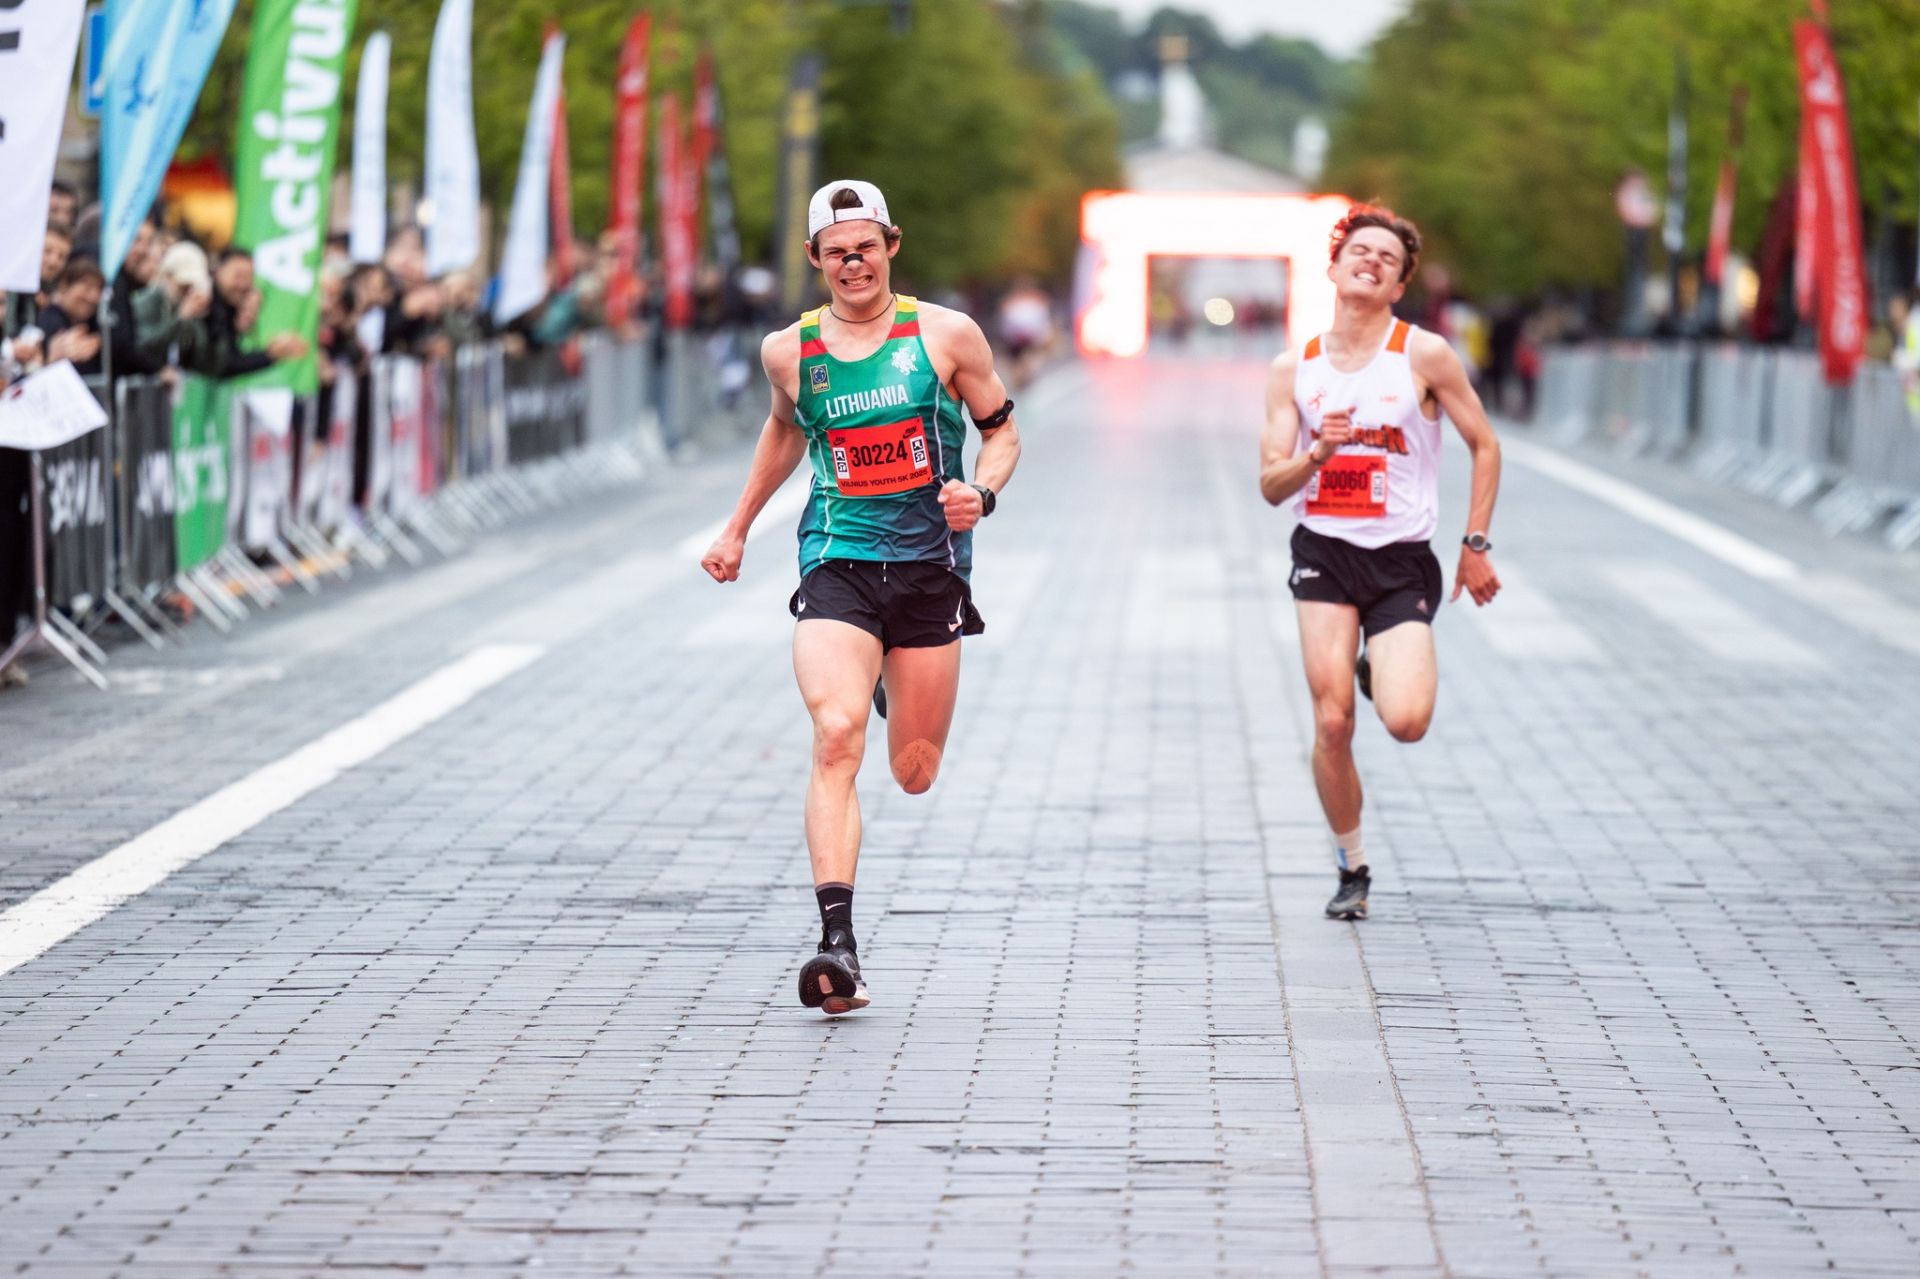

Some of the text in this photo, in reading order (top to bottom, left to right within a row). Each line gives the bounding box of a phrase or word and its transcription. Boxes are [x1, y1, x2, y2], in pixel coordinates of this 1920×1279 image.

[253, 0, 347, 295] Activu
[826, 384, 909, 418] LITHUANIA
[849, 440, 908, 468] 30224
[870, 477, 897, 486] YOUTH
[909, 469, 928, 479] 2025
[1322, 470, 1368, 490] 30060
